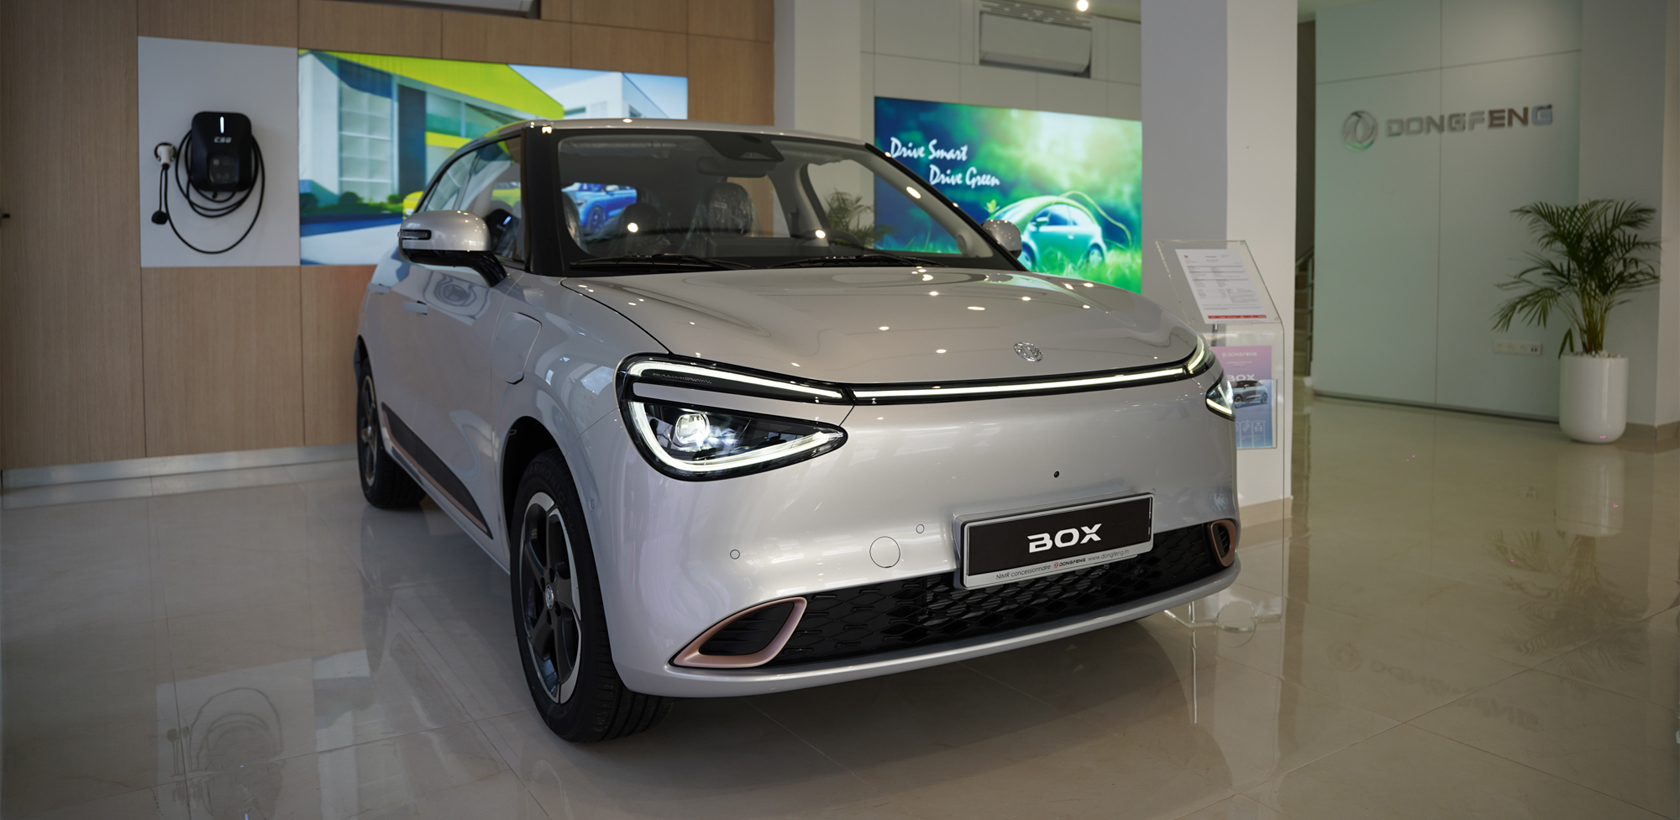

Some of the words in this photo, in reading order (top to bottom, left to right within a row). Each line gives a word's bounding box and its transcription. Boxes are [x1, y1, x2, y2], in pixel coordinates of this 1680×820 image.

[1386, 104, 1553, 138] DONGFENG
[890, 136, 925, 159] Drive
[928, 139, 968, 161] Smart
[929, 164, 962, 185] Drive
[965, 166, 1000, 189] Green
[1027, 523, 1102, 553] BOX
[1010, 564, 1051, 578] concessionnaire
[1058, 557, 1086, 567] DONGFENG
